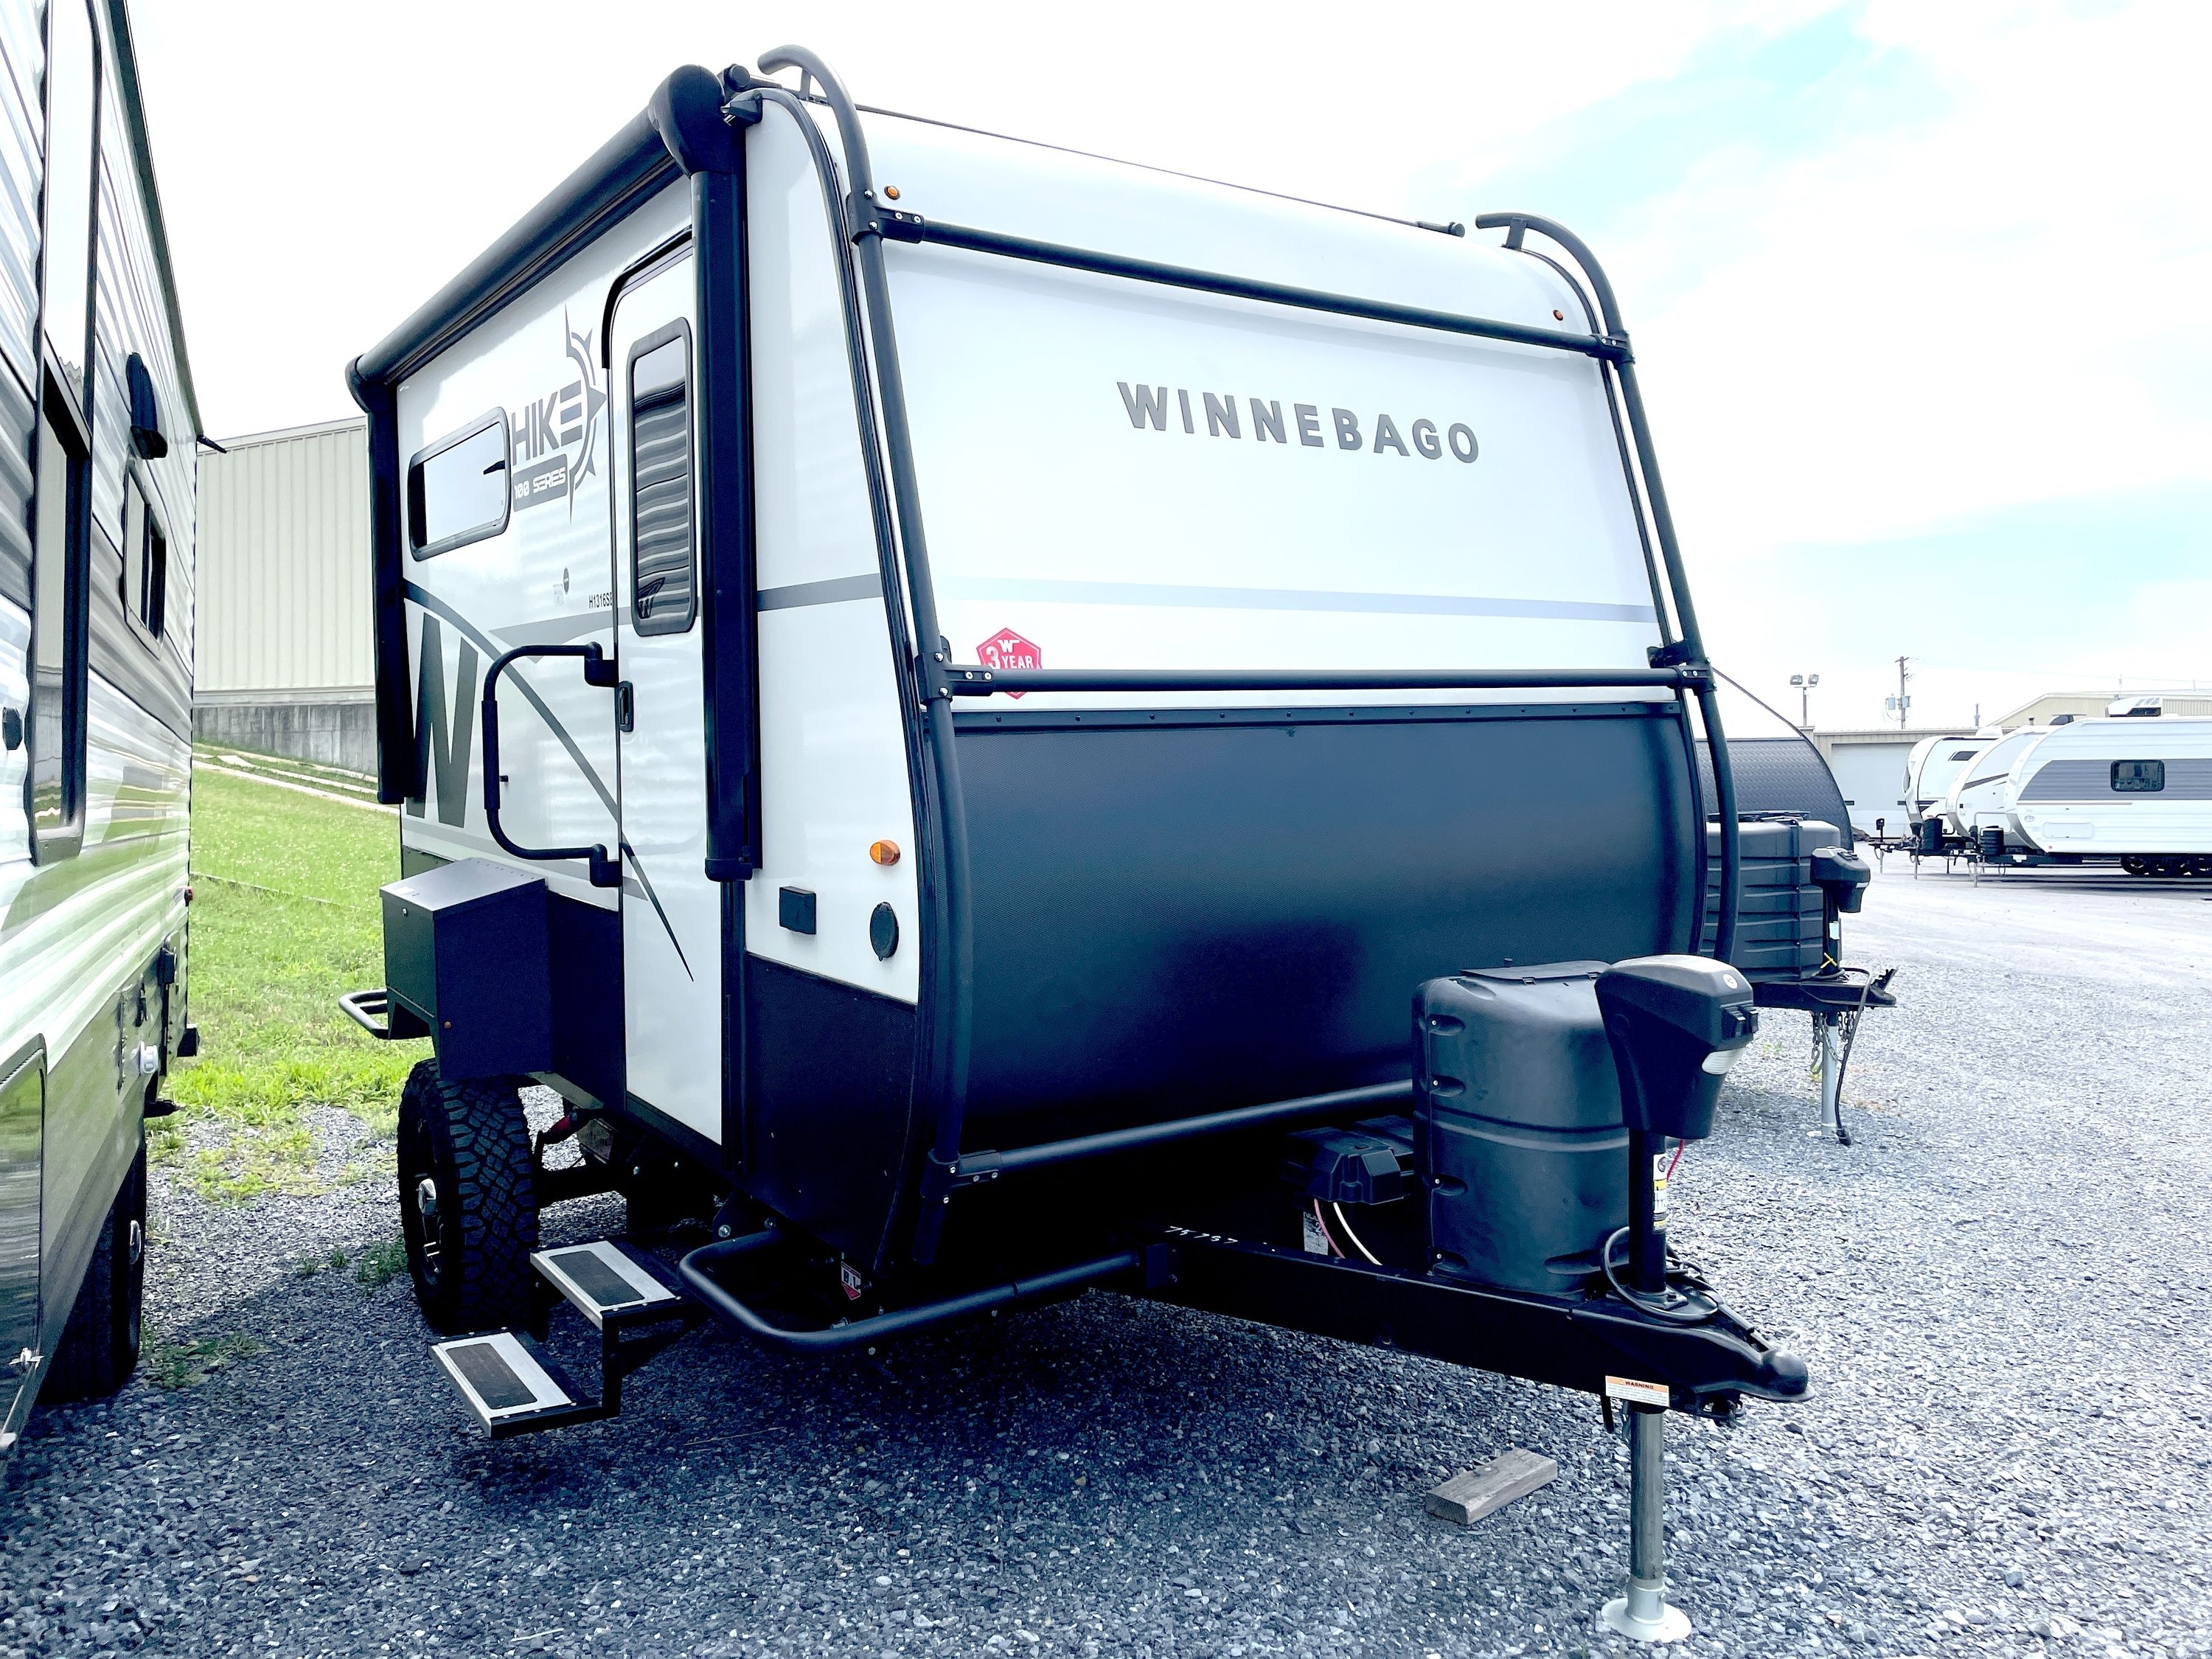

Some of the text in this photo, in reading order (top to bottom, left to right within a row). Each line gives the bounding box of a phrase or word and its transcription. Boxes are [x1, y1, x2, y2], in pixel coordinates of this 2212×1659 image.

[512, 380, 582, 466] HIKE
[1117, 382, 1479, 464] WINNEBAGO
[514, 467, 566, 500] 100 SERIES
[986, 646, 1034, 669] 3 YEAR
[1626, 1381, 1654, 1390] WARNING
